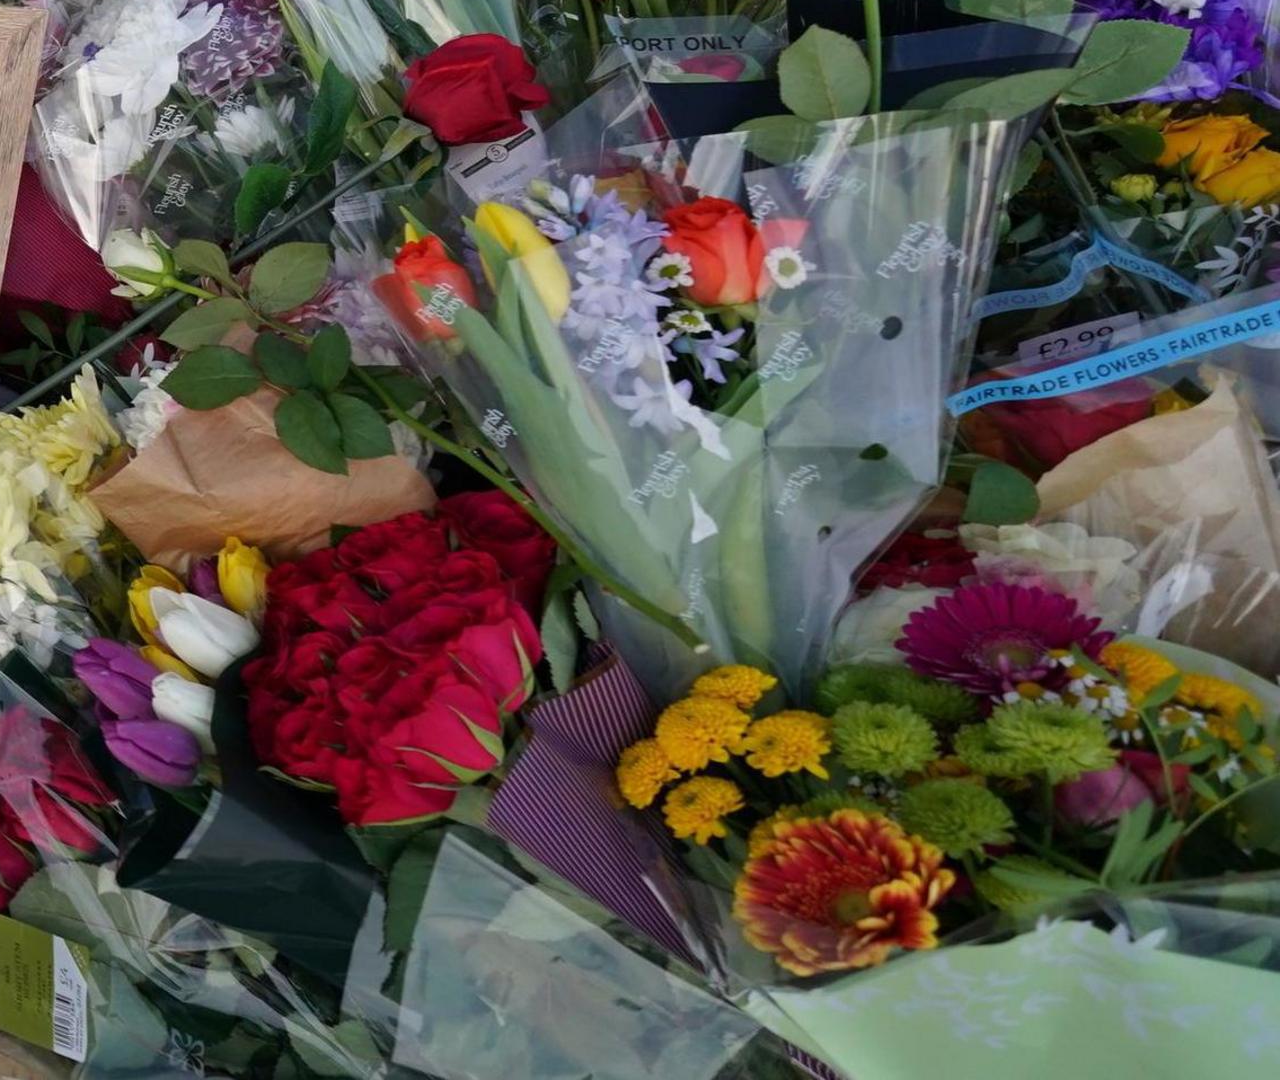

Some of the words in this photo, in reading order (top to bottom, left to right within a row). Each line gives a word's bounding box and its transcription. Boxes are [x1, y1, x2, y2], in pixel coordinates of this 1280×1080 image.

[620, 36, 676, 52] PORT
[683, 36, 746, 51] ONLY
[877, 220, 931, 279] Flourish
[955, 371, 1070, 410] FAIRTRADE
[1075, 348, 1159, 385] FLOWERS
[1169, 313, 1274, 356] FAIRTRADE
[1038, 325, 1115, 360] £2.99
